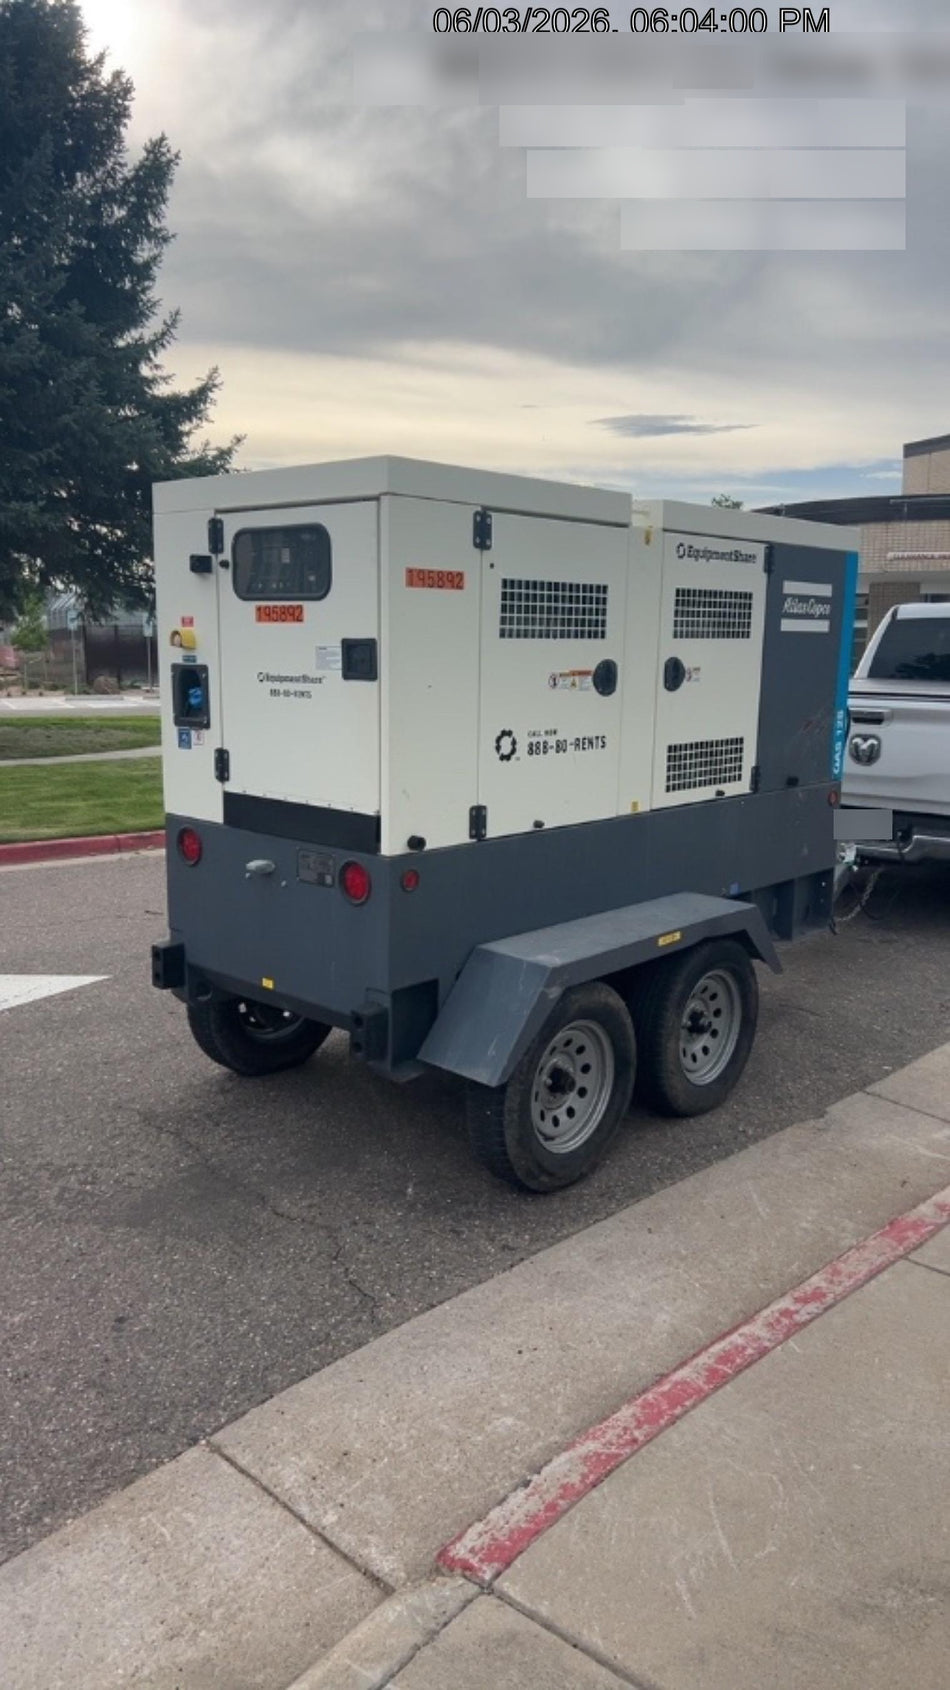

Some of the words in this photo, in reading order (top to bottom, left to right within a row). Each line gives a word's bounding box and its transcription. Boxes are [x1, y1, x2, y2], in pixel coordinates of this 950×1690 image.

[687, 545, 757, 564] EquipmentShare
[407, 568, 464, 590] 195892
[256, 604, 304, 622] 195892
